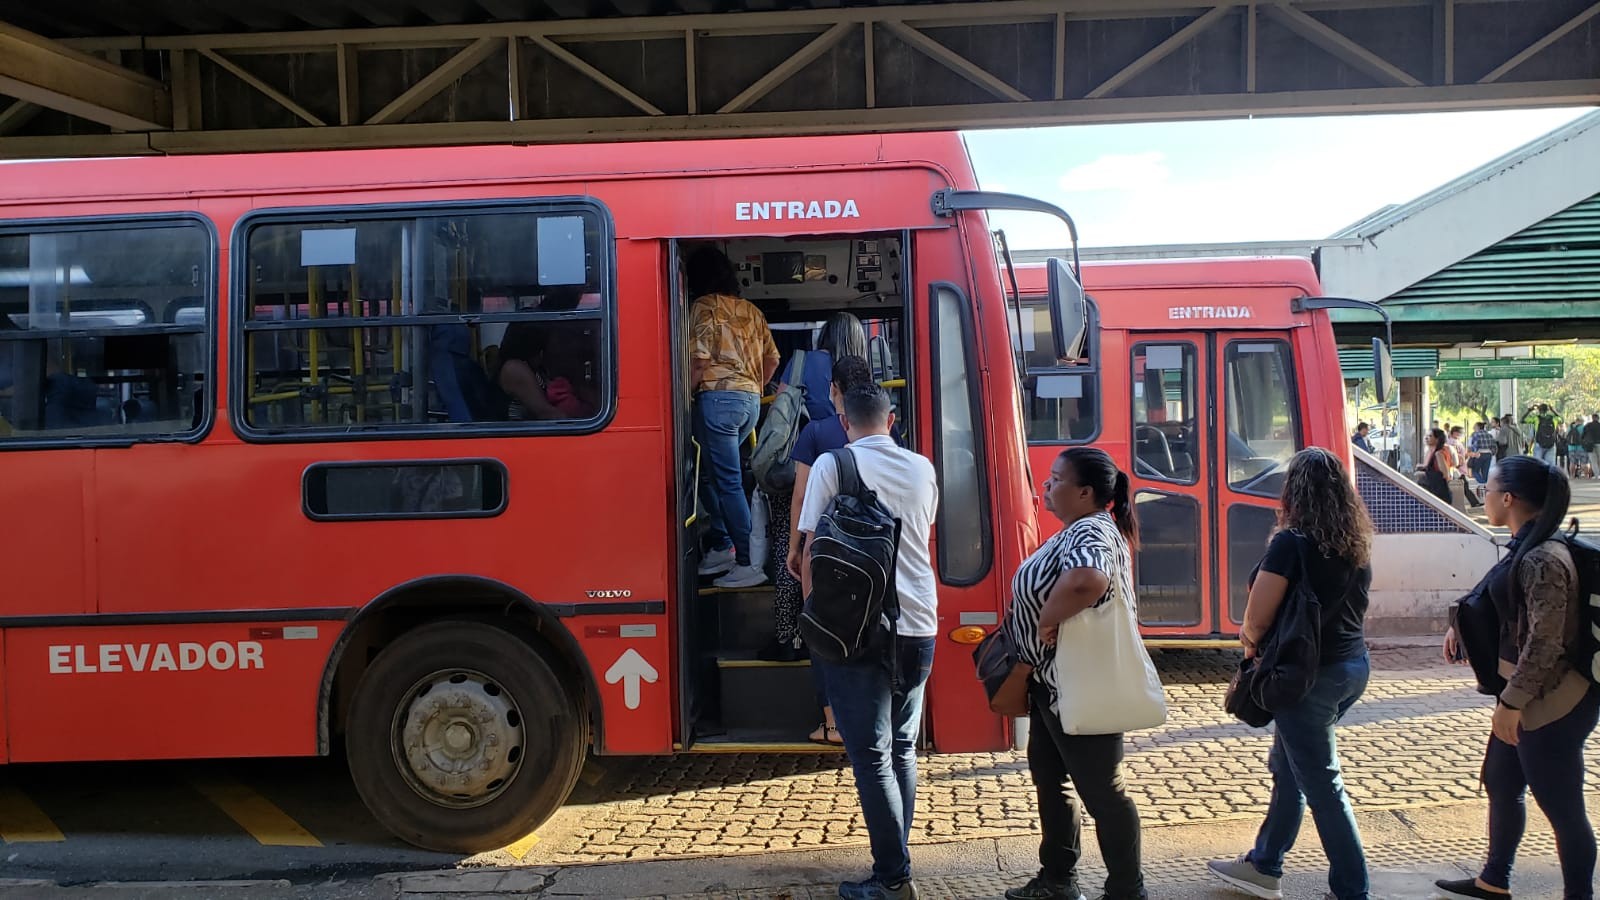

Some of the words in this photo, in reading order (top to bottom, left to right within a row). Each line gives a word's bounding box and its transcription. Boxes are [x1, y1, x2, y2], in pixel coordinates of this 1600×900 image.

[735, 199, 860, 220] ENTRADA
[1168, 305, 1252, 319] ENTRADA
[585, 590, 631, 598] VOLVO
[49, 641, 264, 674] ELEVADOR
